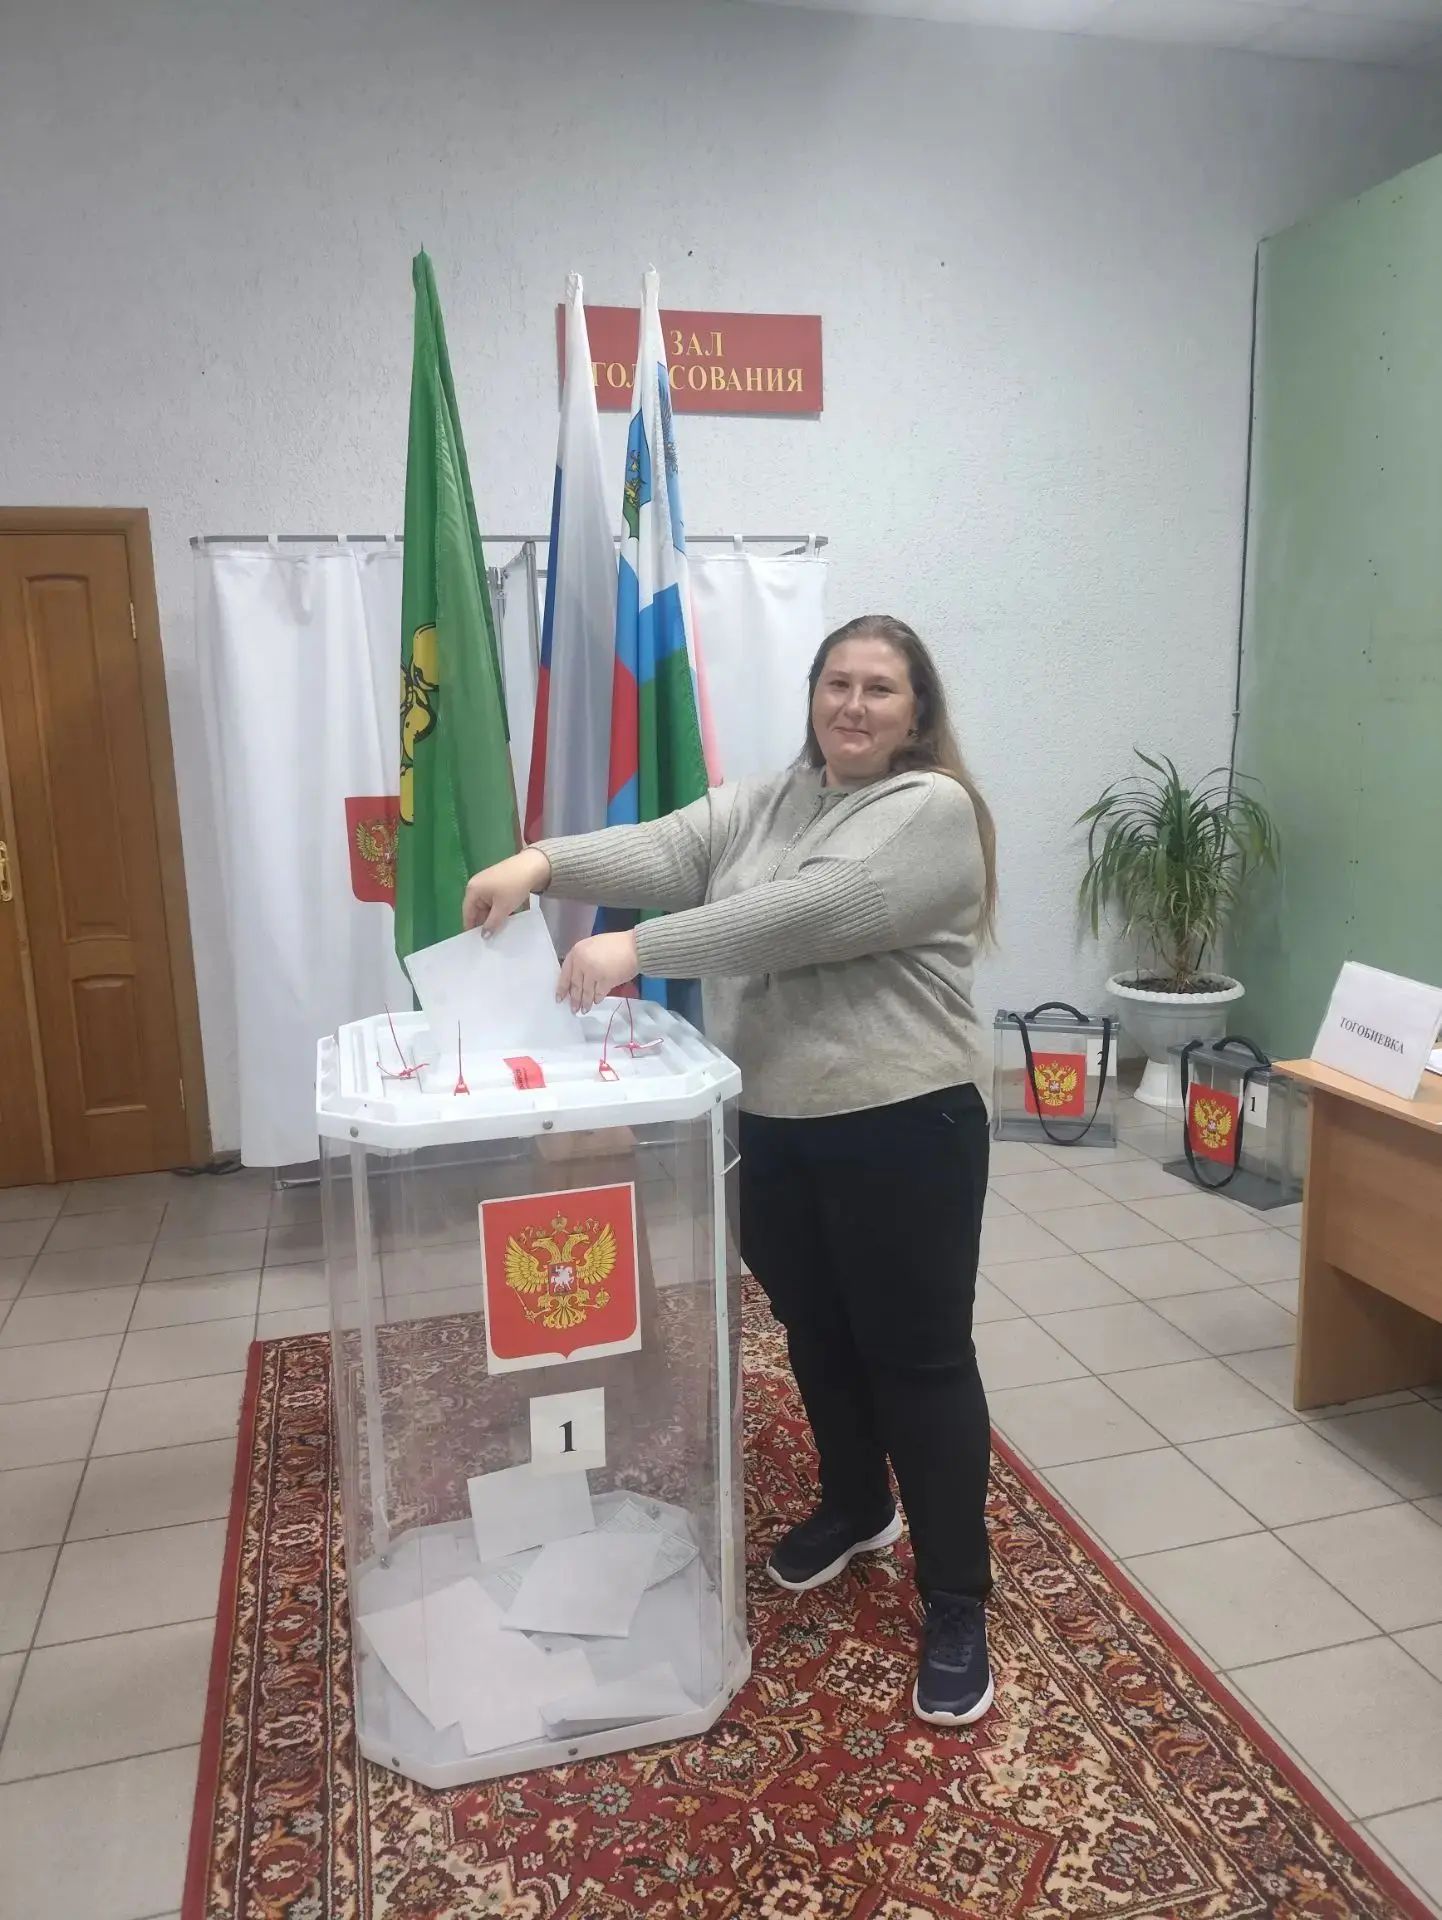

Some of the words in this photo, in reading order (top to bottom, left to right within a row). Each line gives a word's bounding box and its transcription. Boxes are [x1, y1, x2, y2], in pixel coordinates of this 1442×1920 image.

[670, 329, 724, 357] ЗАЛ
[591, 361, 805, 392] ГОСОВАНИЯ
[1340, 1017, 1405, 1055] ТОГОБИЕВКА
[1250, 1096, 1256, 1112] 1
[559, 1420, 577, 1454] 1
